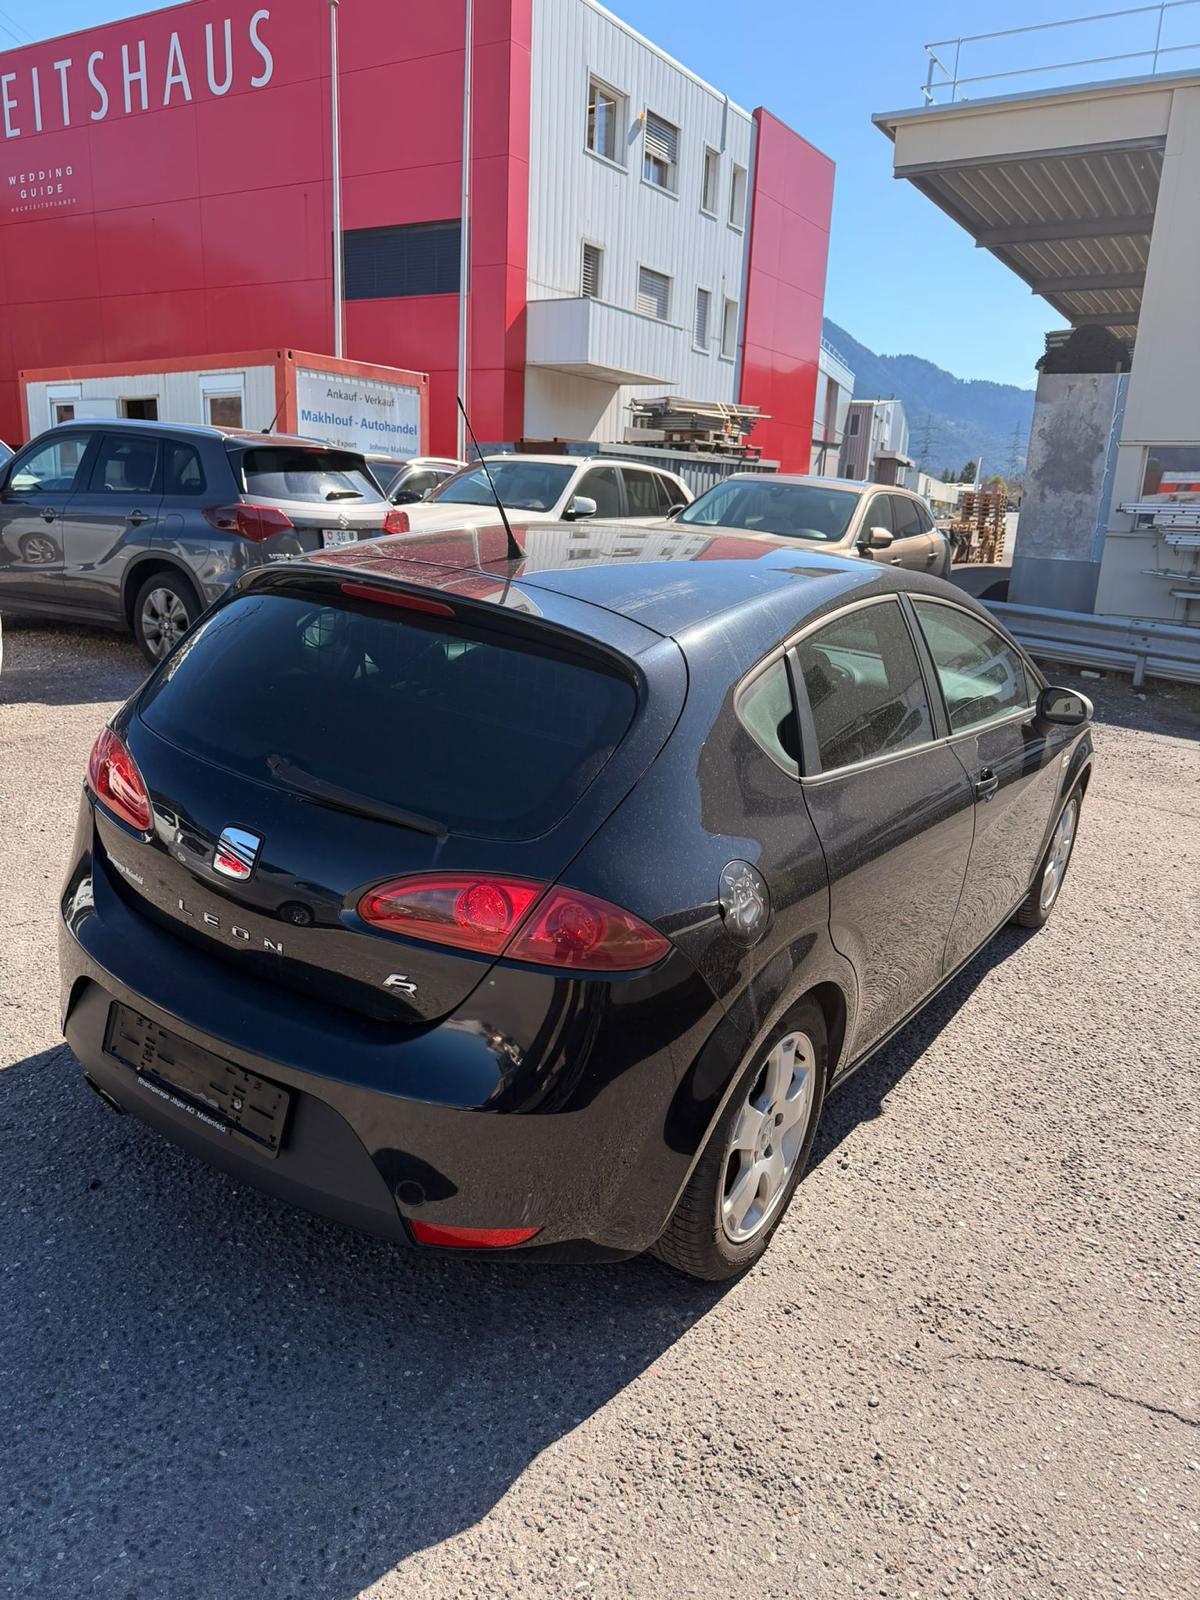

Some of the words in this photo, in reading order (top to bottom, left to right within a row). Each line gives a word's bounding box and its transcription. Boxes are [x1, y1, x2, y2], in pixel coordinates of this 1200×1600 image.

[8, 166, 73, 185] WEDDING
[20, 183, 63, 199] GUIDE
[326, 388, 357, 402] Ankauf
[364, 394, 395, 407] Verkauf
[301, 409, 353, 427] Makhlouf
[360, 418, 418, 436] Autohandel
[178, 899, 283, 955] LEON
